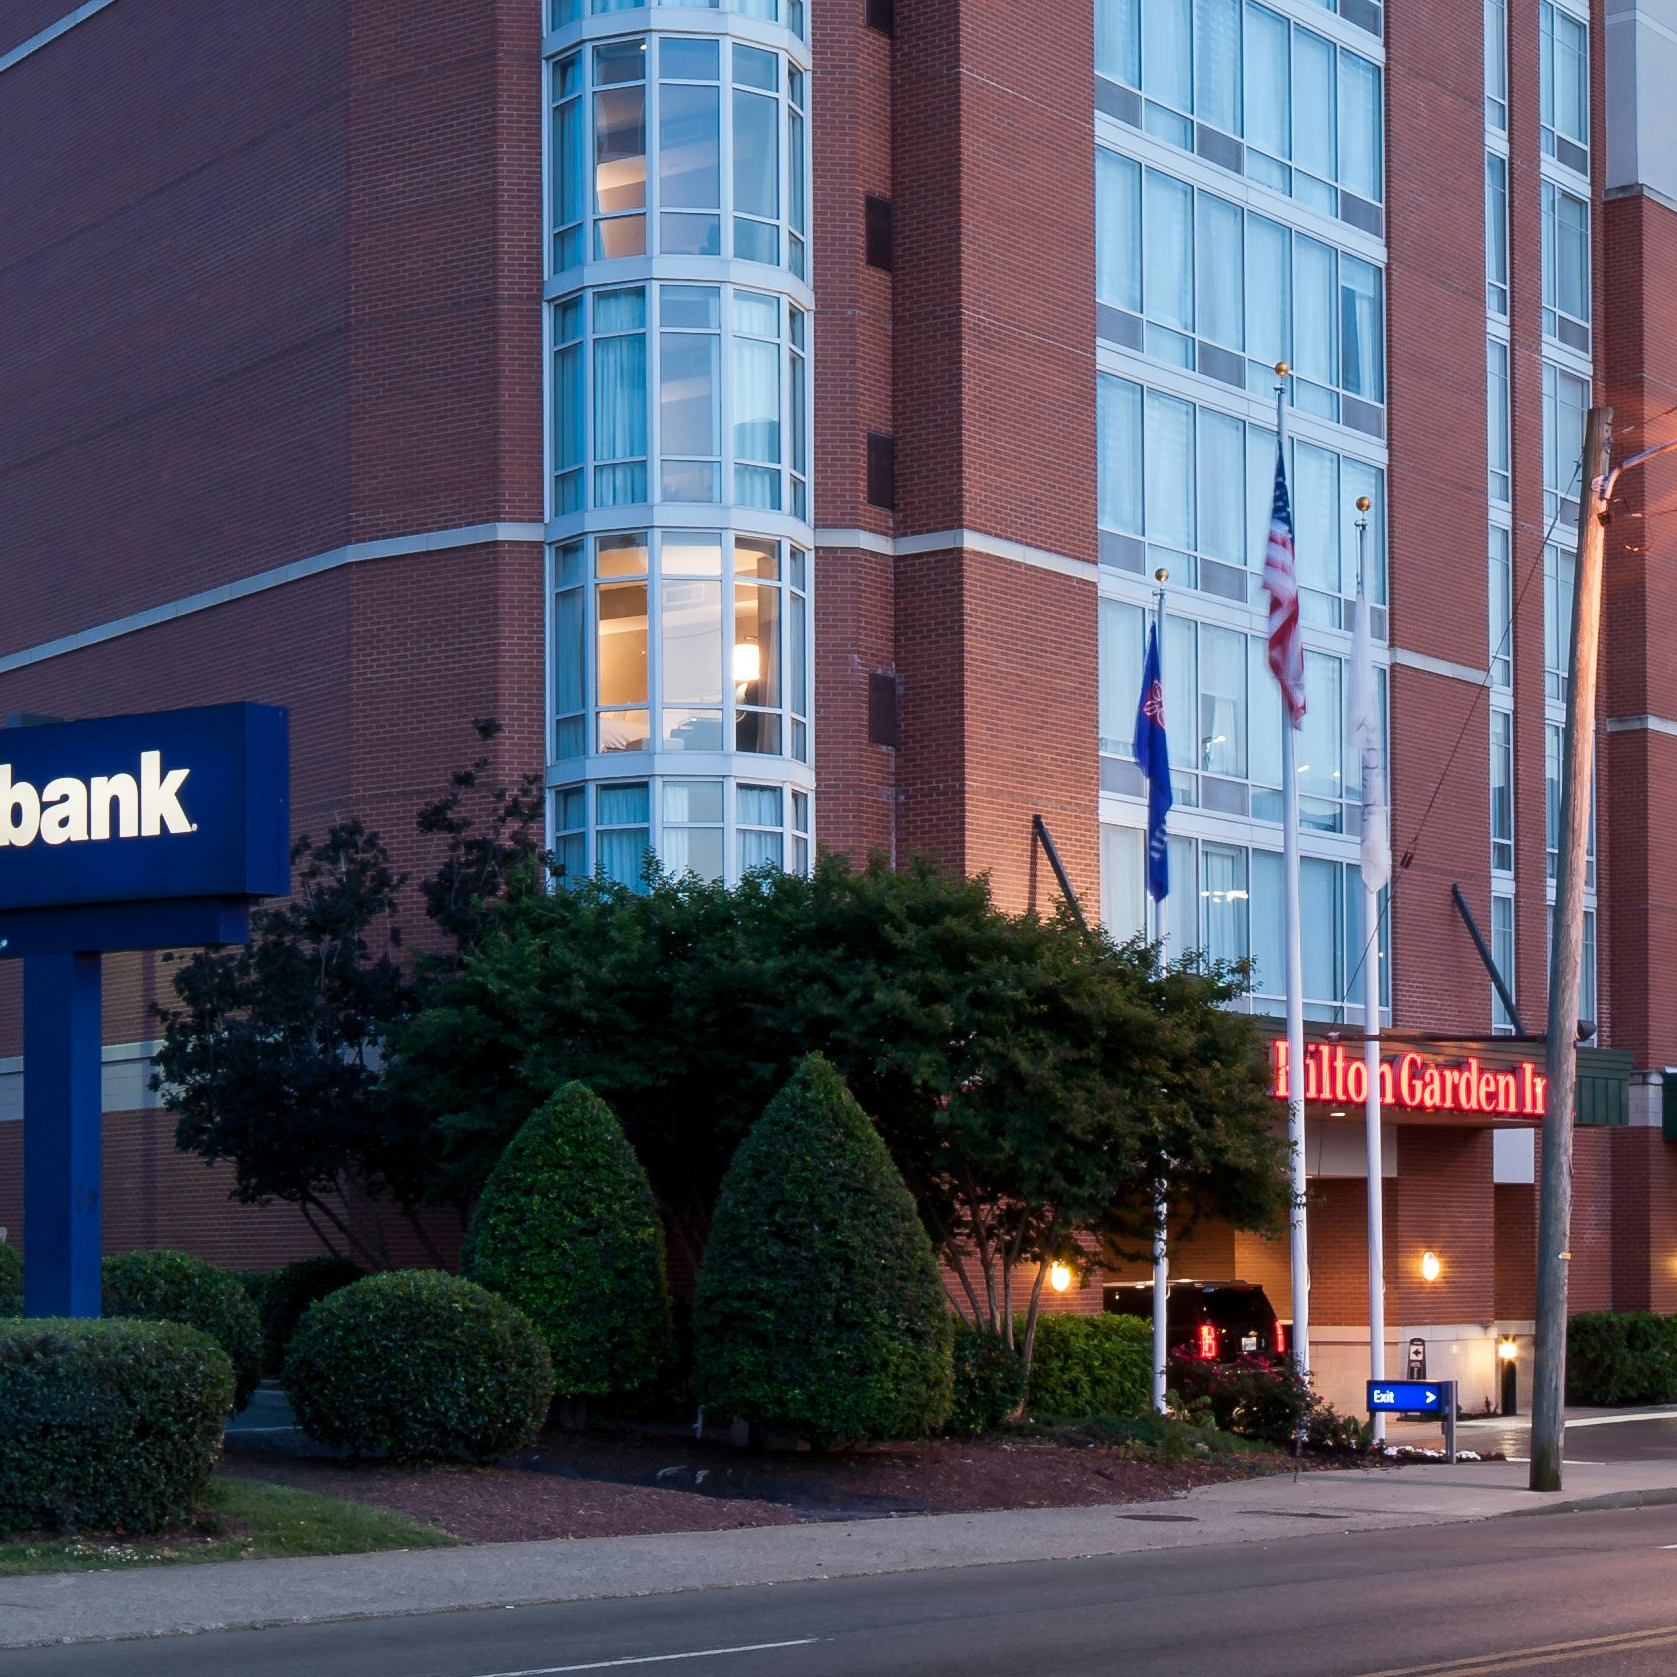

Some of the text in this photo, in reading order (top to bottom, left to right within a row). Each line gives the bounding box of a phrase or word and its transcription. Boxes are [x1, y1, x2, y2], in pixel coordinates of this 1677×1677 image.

[1396, 1052, 1519, 1114] Garden
[1518, 1061, 1547, 1116] In
[1373, 1389, 1395, 1404] Exit
